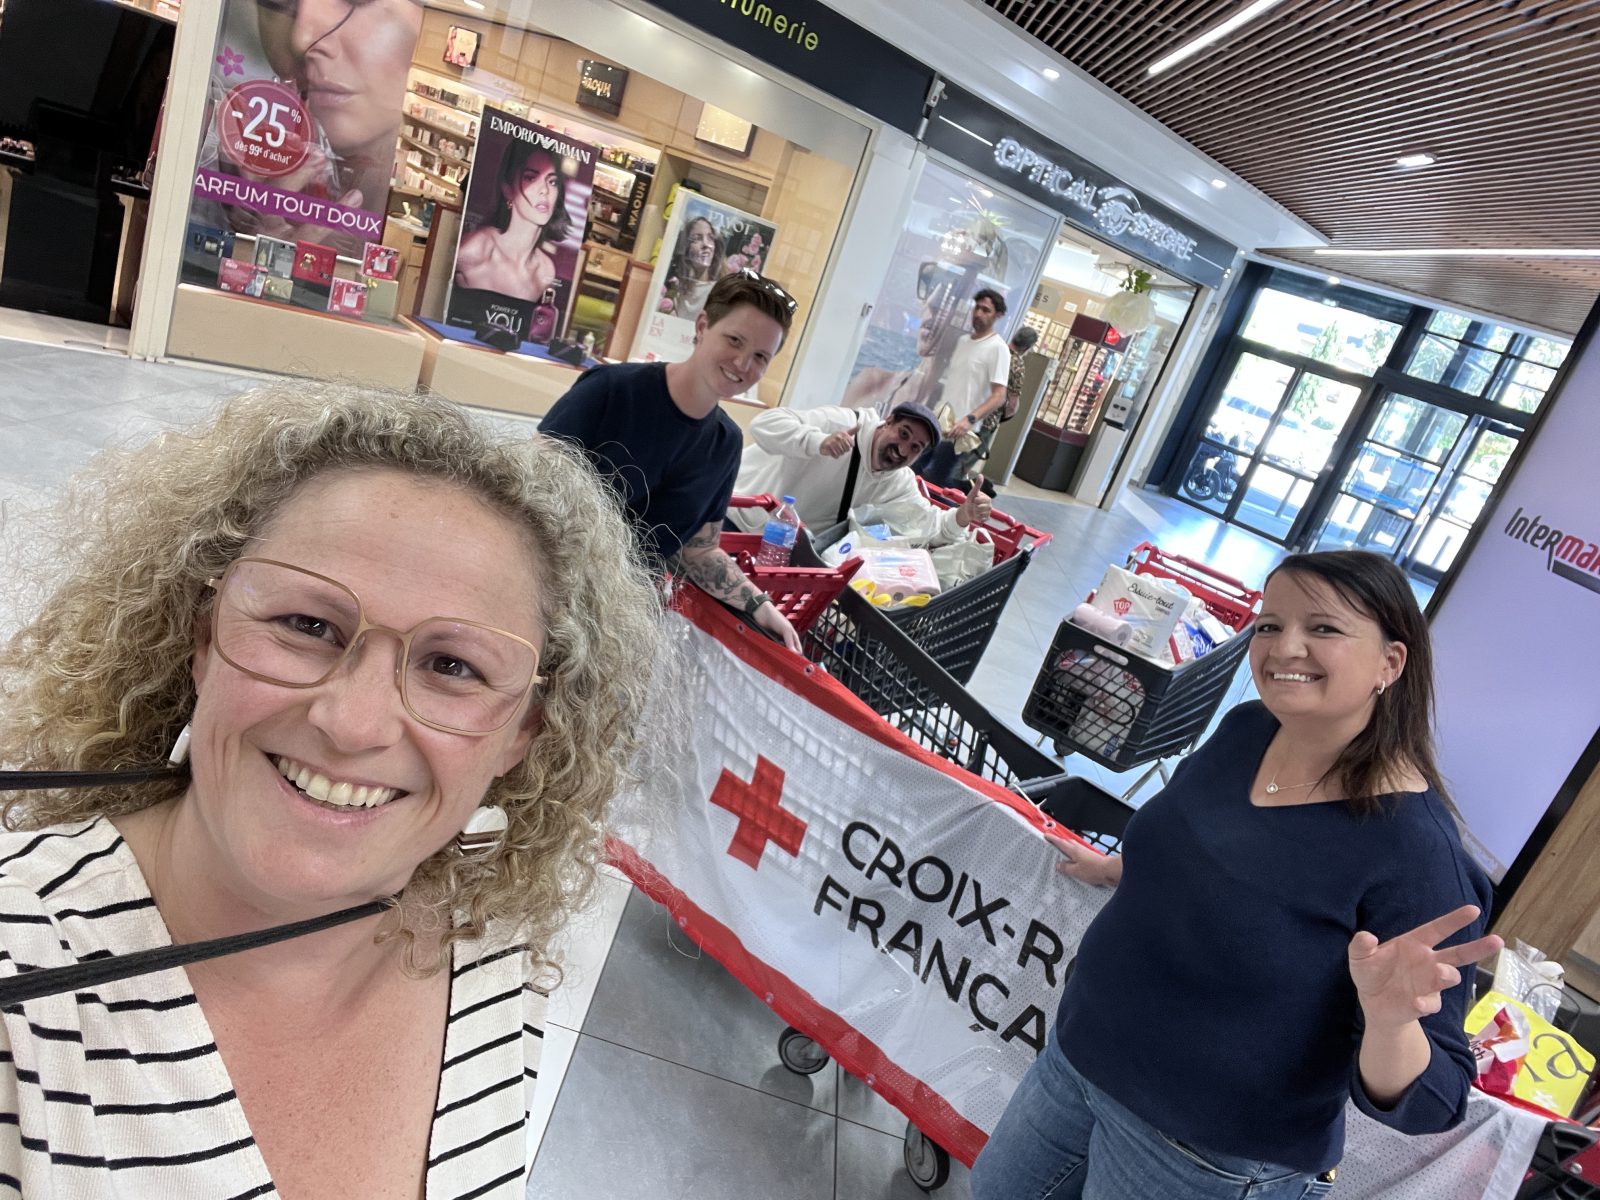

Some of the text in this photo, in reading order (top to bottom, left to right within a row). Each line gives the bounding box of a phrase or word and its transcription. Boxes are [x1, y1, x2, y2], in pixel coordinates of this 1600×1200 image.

[720, 0, 819, 50] umerie
[490, 116, 592, 165] EMPORIO ARMANI
[272, 192, 325, 219] TOUT
[327, 207, 382, 234] DOUX
[627, 181, 649, 228] WAOUH
[994, 136, 1198, 261] OPTICAL STORE
[708, 209, 751, 236] PAYOT
[485, 310, 522, 334] YOU
[491, 304, 511, 314] POWER
[1113, 599, 1132, 610] TOP
[841, 821, 1077, 988] CROIX-R
[813, 874, 1046, 1055] FRANÇA
